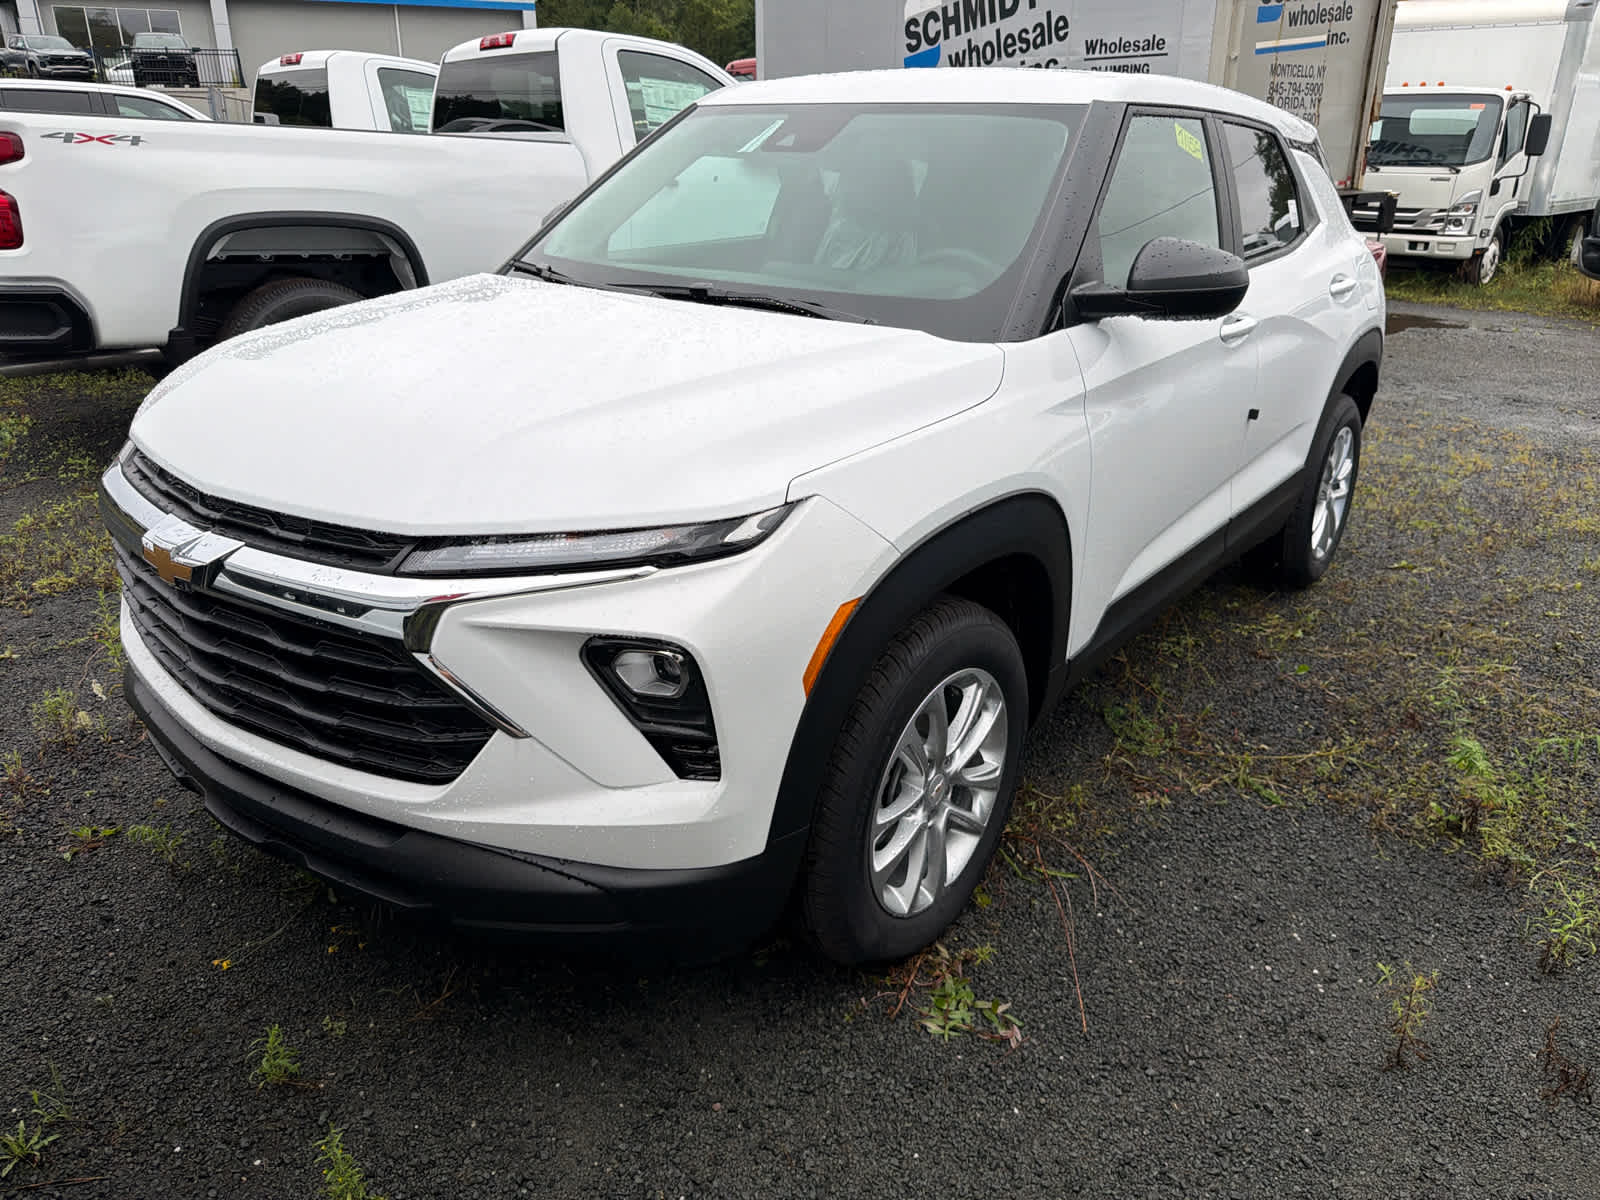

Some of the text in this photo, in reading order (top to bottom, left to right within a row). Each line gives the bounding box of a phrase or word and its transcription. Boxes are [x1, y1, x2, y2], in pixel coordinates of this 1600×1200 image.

[1288, 1, 1353, 28] wholesale
[905, 0, 1037, 54] SCHMID
[1326, 29, 1350, 46] inc.
[948, 10, 1070, 68] wholesale
[1085, 34, 1166, 55] Wholesale
[1270, 63, 1327, 80] MONTICELLO, NY
[1268, 81, 1324, 97] 845-794-5900
